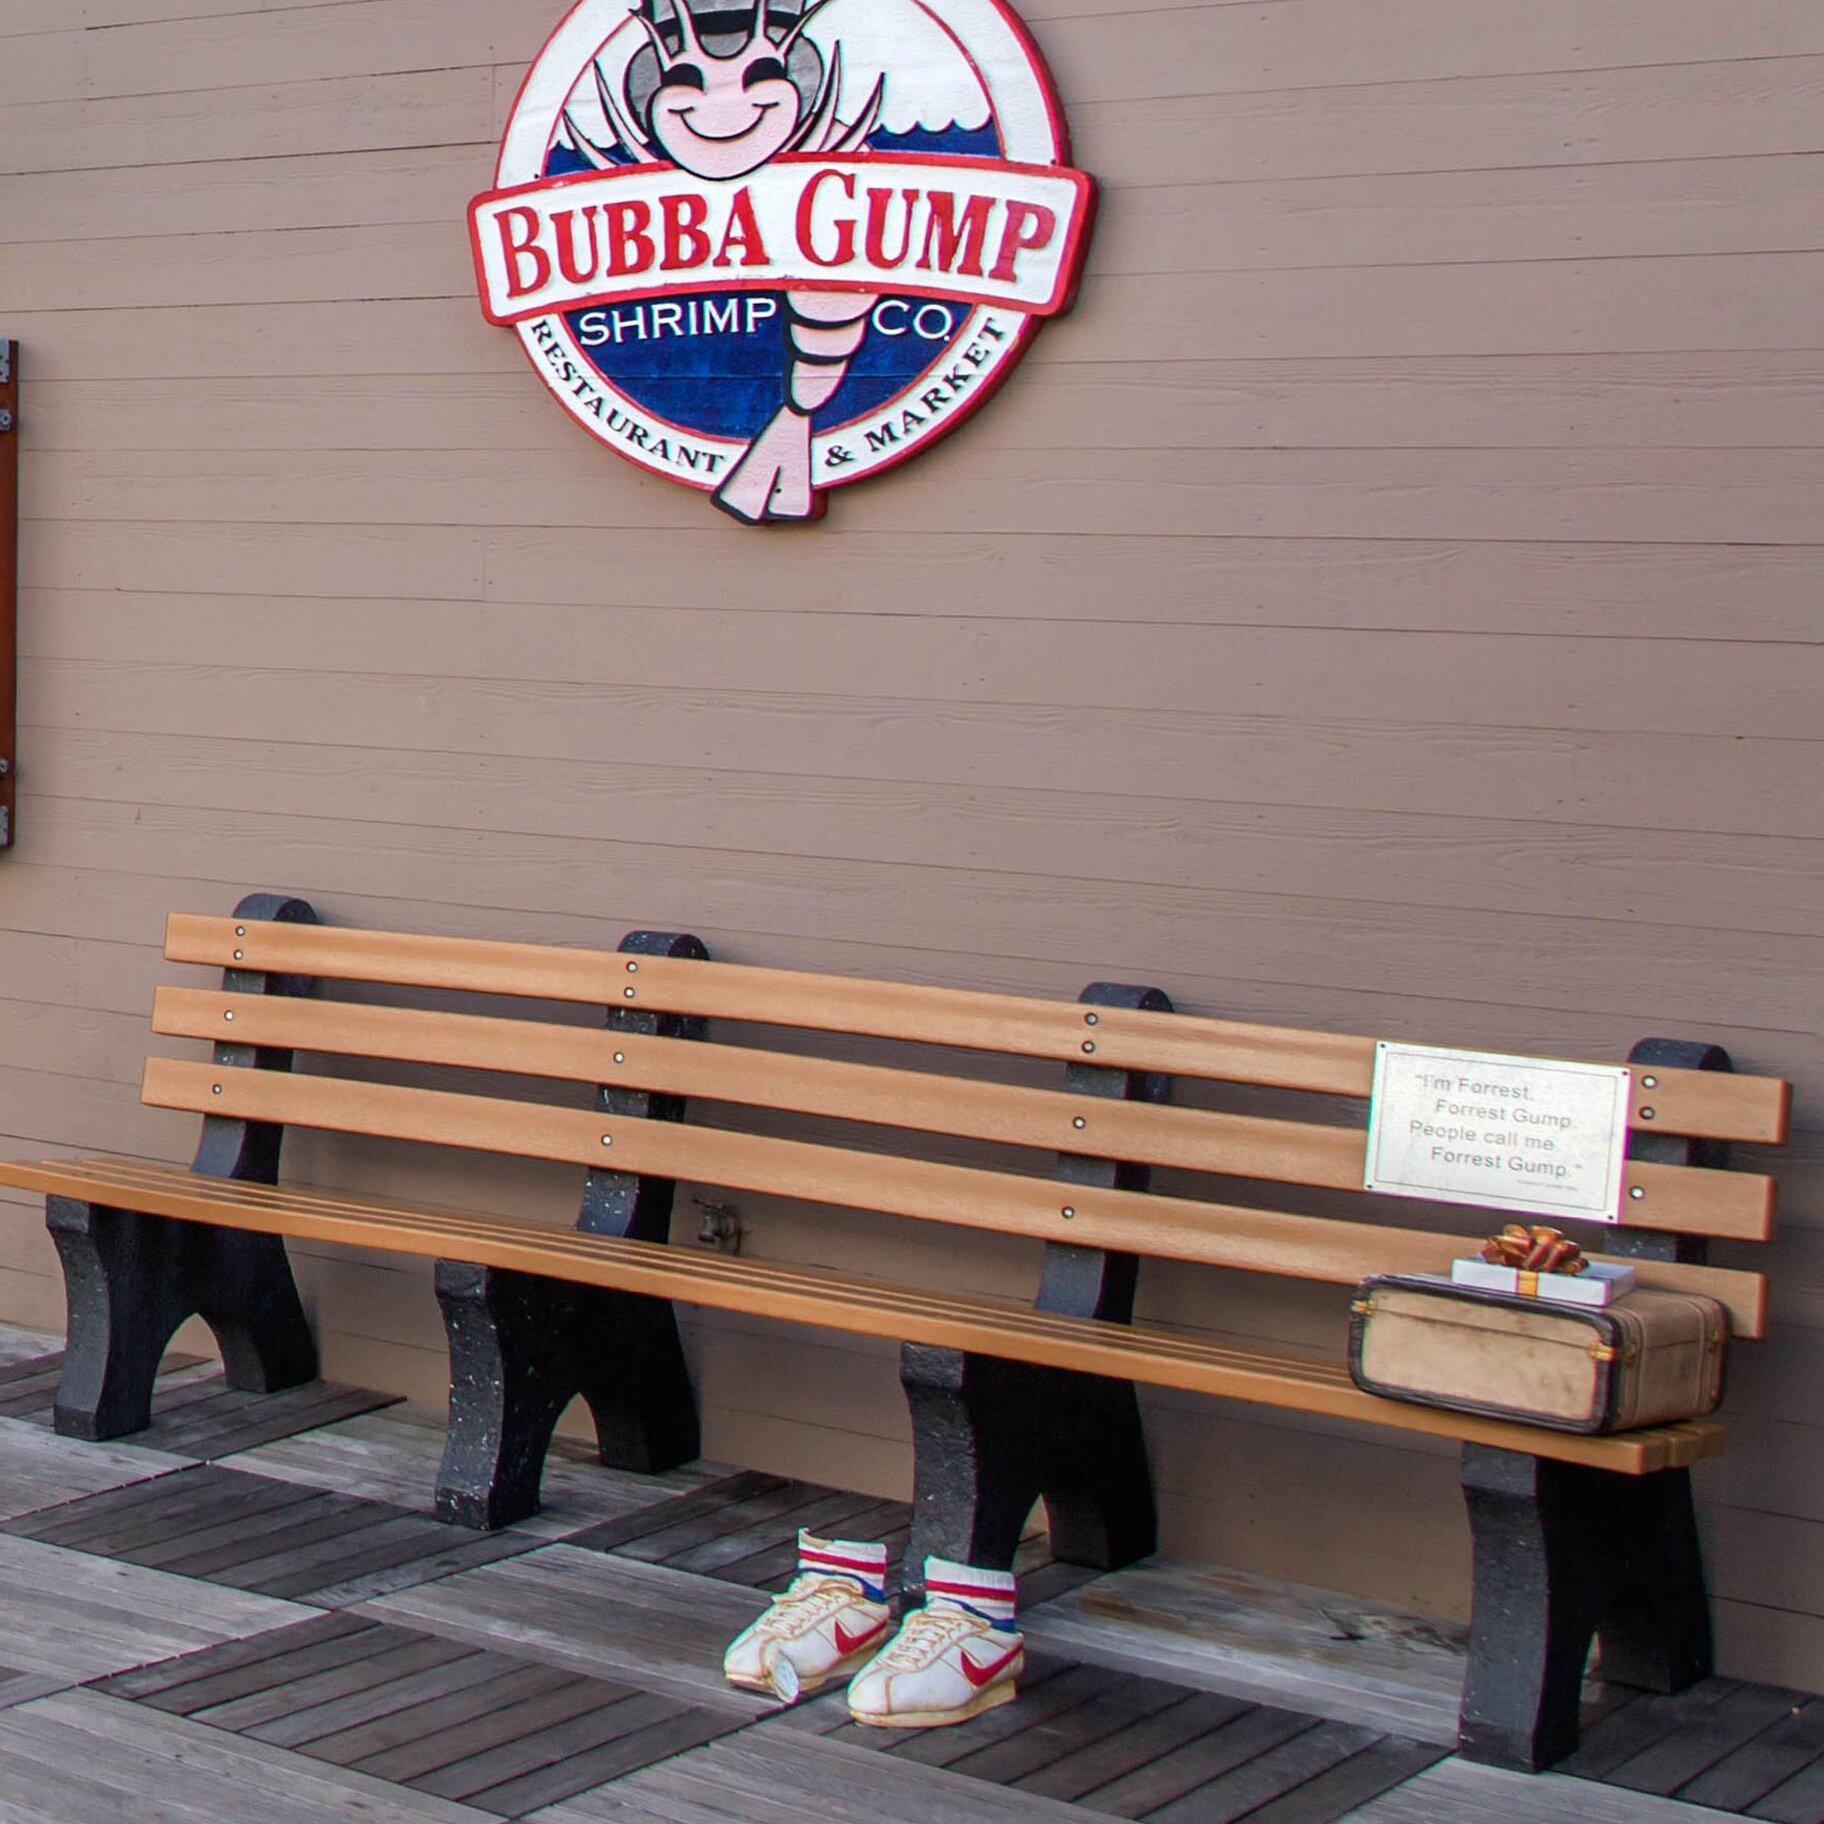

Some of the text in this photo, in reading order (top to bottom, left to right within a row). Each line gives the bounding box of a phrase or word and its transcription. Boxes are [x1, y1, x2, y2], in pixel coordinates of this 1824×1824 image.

[493, 167, 1055, 300] BUBBA GUMP
[579, 295, 952, 347] SHRIMP CO.
[531, 316, 1007, 474] RESTAURANT & MARKET
[1458, 1078, 1535, 1101] Forrest.
[1435, 1099, 1506, 1120] Forrest
[1409, 1120, 1554, 1151] People call me
[1431, 1147, 1502, 1169] Forrest
